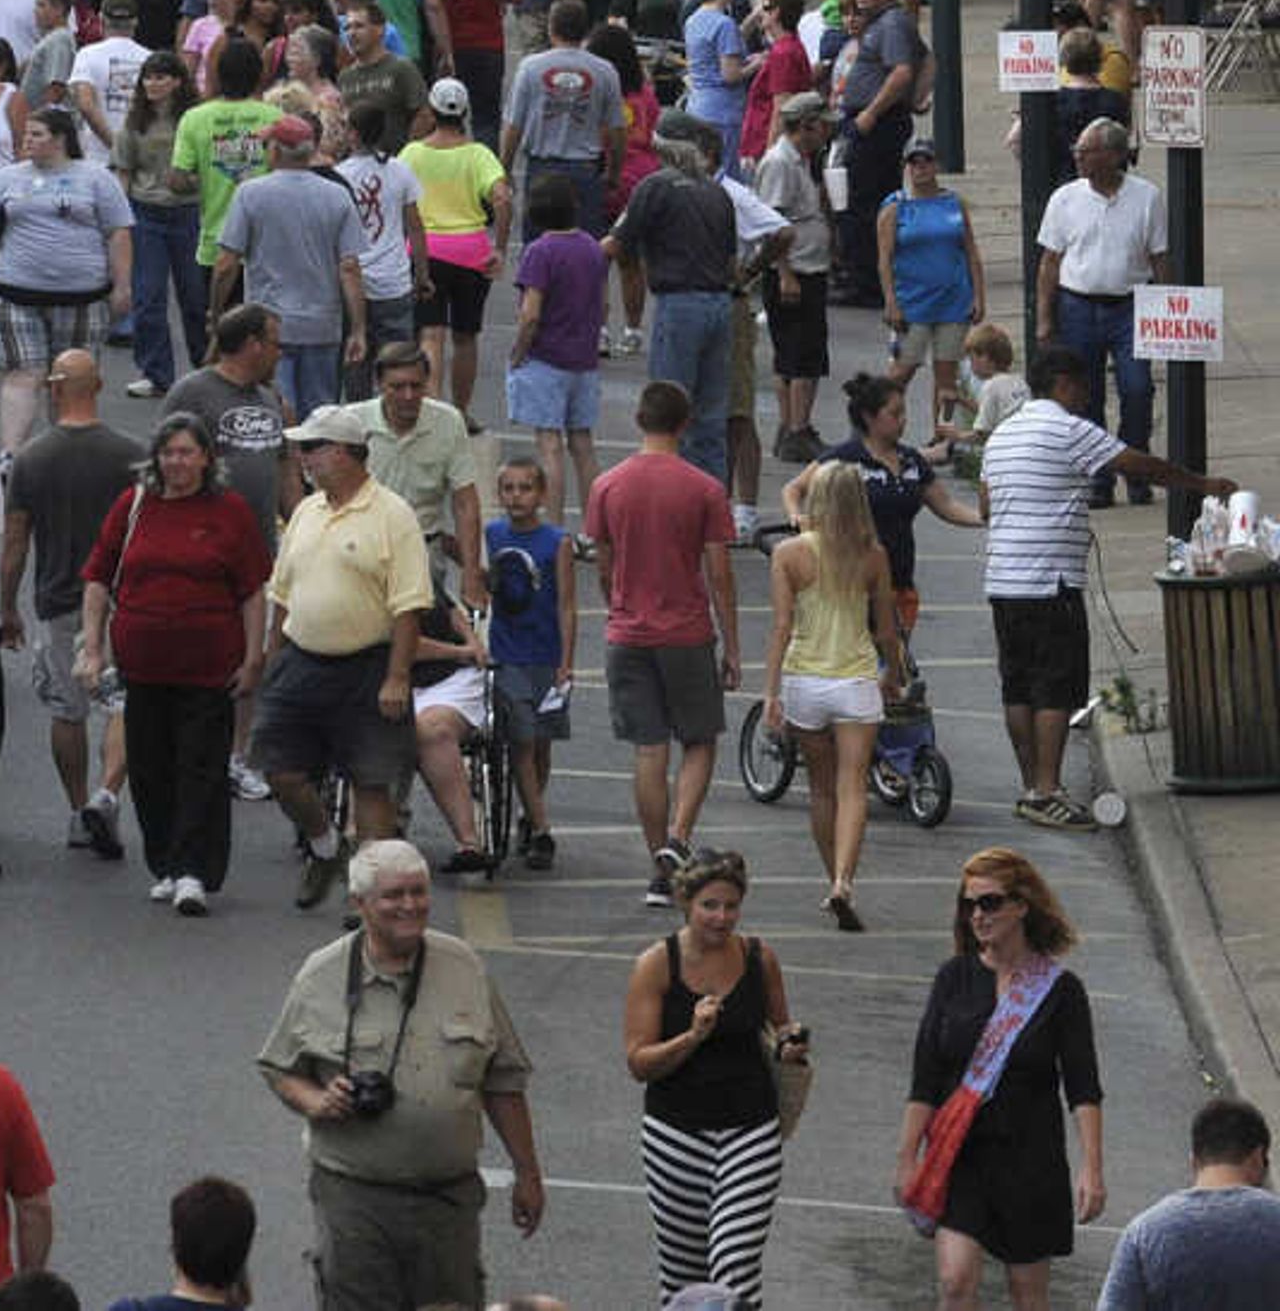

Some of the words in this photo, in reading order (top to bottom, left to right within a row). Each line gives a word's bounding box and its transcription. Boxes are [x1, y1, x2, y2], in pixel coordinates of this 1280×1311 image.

[1159, 37, 1185, 60] NO
[1002, 56, 1056, 74] PARKING
[1144, 67, 1204, 88] PARKING
[1167, 295, 1190, 316] NO
[1139, 318, 1217, 342] PARKING
